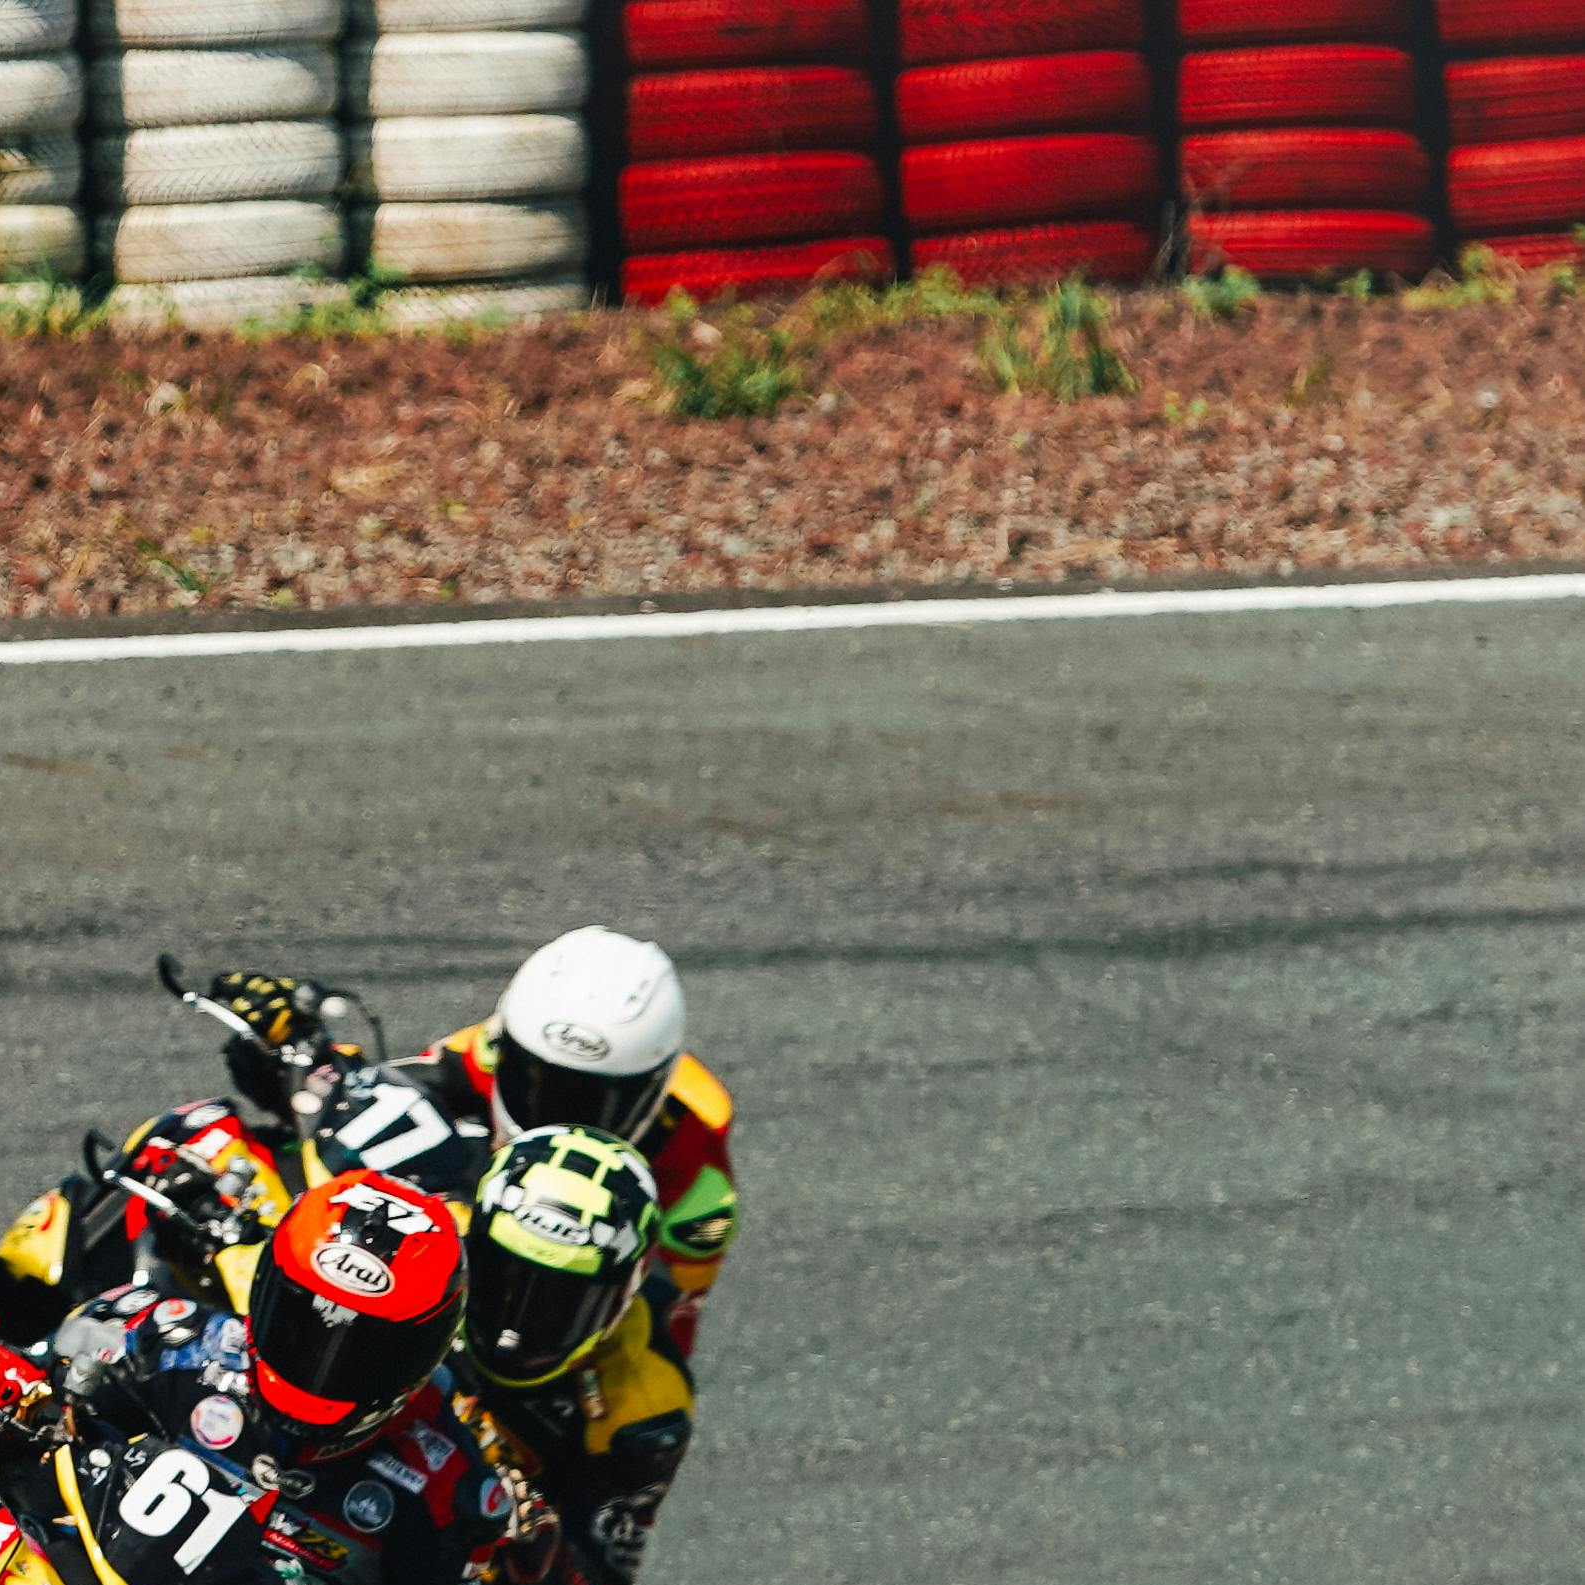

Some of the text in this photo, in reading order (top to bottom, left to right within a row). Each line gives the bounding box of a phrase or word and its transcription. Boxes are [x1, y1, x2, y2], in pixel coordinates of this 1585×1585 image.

[335, 1082, 453, 1171] 17
[321, 1252, 383, 1287] Arai
[118, 1448, 250, 1576] 61
